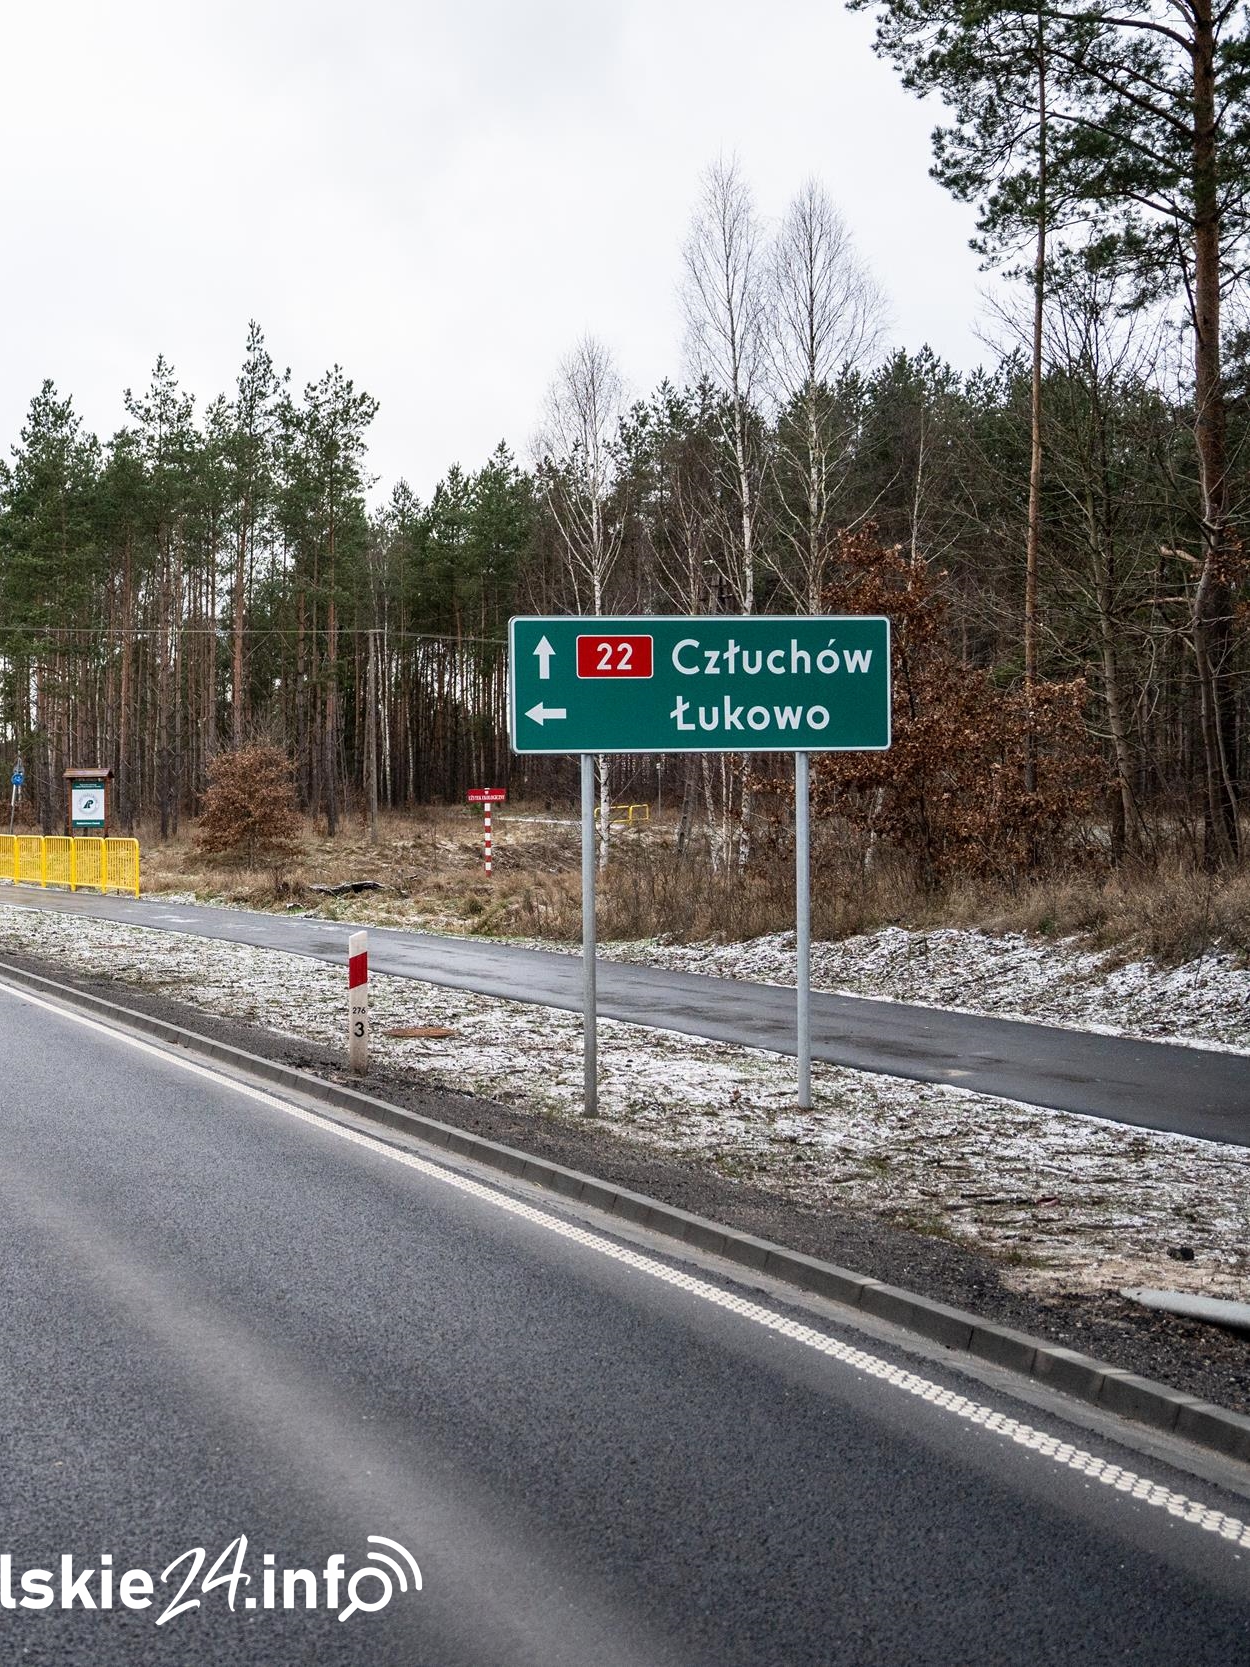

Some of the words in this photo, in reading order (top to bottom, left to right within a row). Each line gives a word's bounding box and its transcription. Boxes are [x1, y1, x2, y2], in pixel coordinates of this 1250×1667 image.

[595, 642, 633, 670] 22
[671, 638, 873, 675] Człuchów
[669, 695, 831, 731] Łukowo
[354, 1021, 365, 1038] 3
